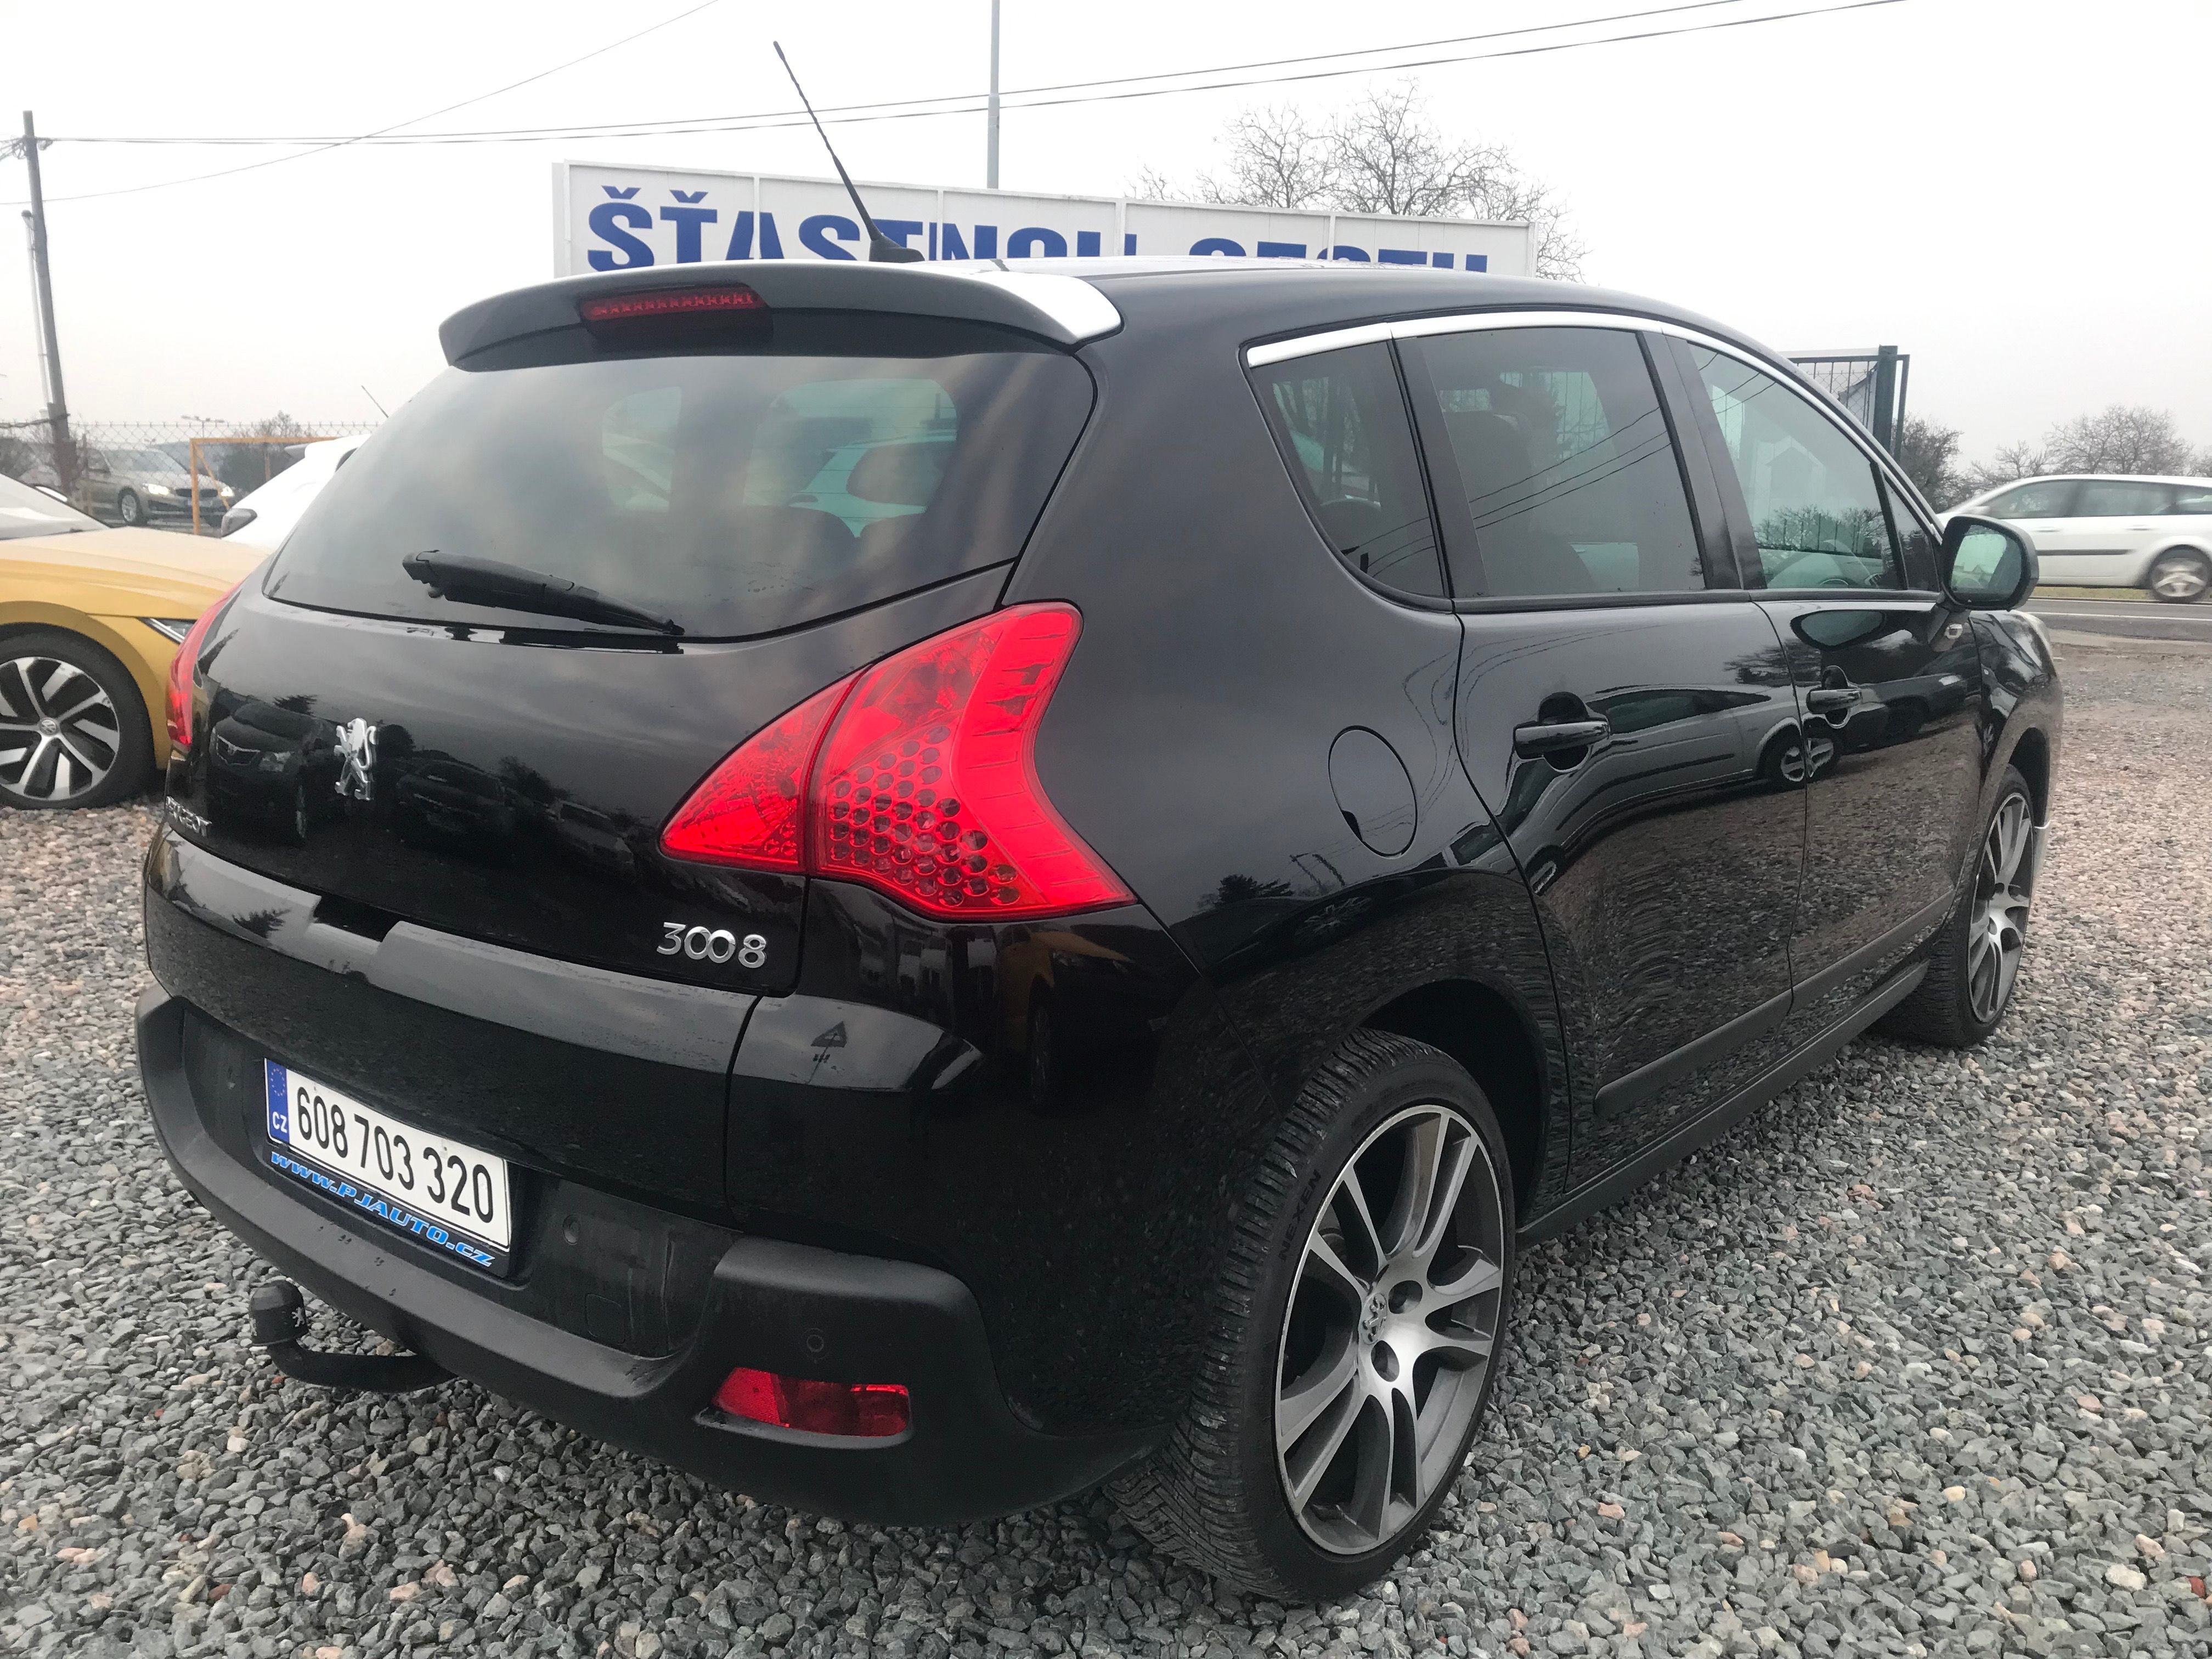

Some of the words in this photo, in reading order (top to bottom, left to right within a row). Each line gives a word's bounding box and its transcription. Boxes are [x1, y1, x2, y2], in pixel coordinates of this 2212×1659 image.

[657, 922, 767, 968] 3008
[272, 1111, 288, 1133] CZ
[297, 1086, 348, 1158] 608
[354, 1114, 415, 1190] 703
[423, 1146, 494, 1223] 320
[1278, 1170, 1322, 1261] NEXEN
